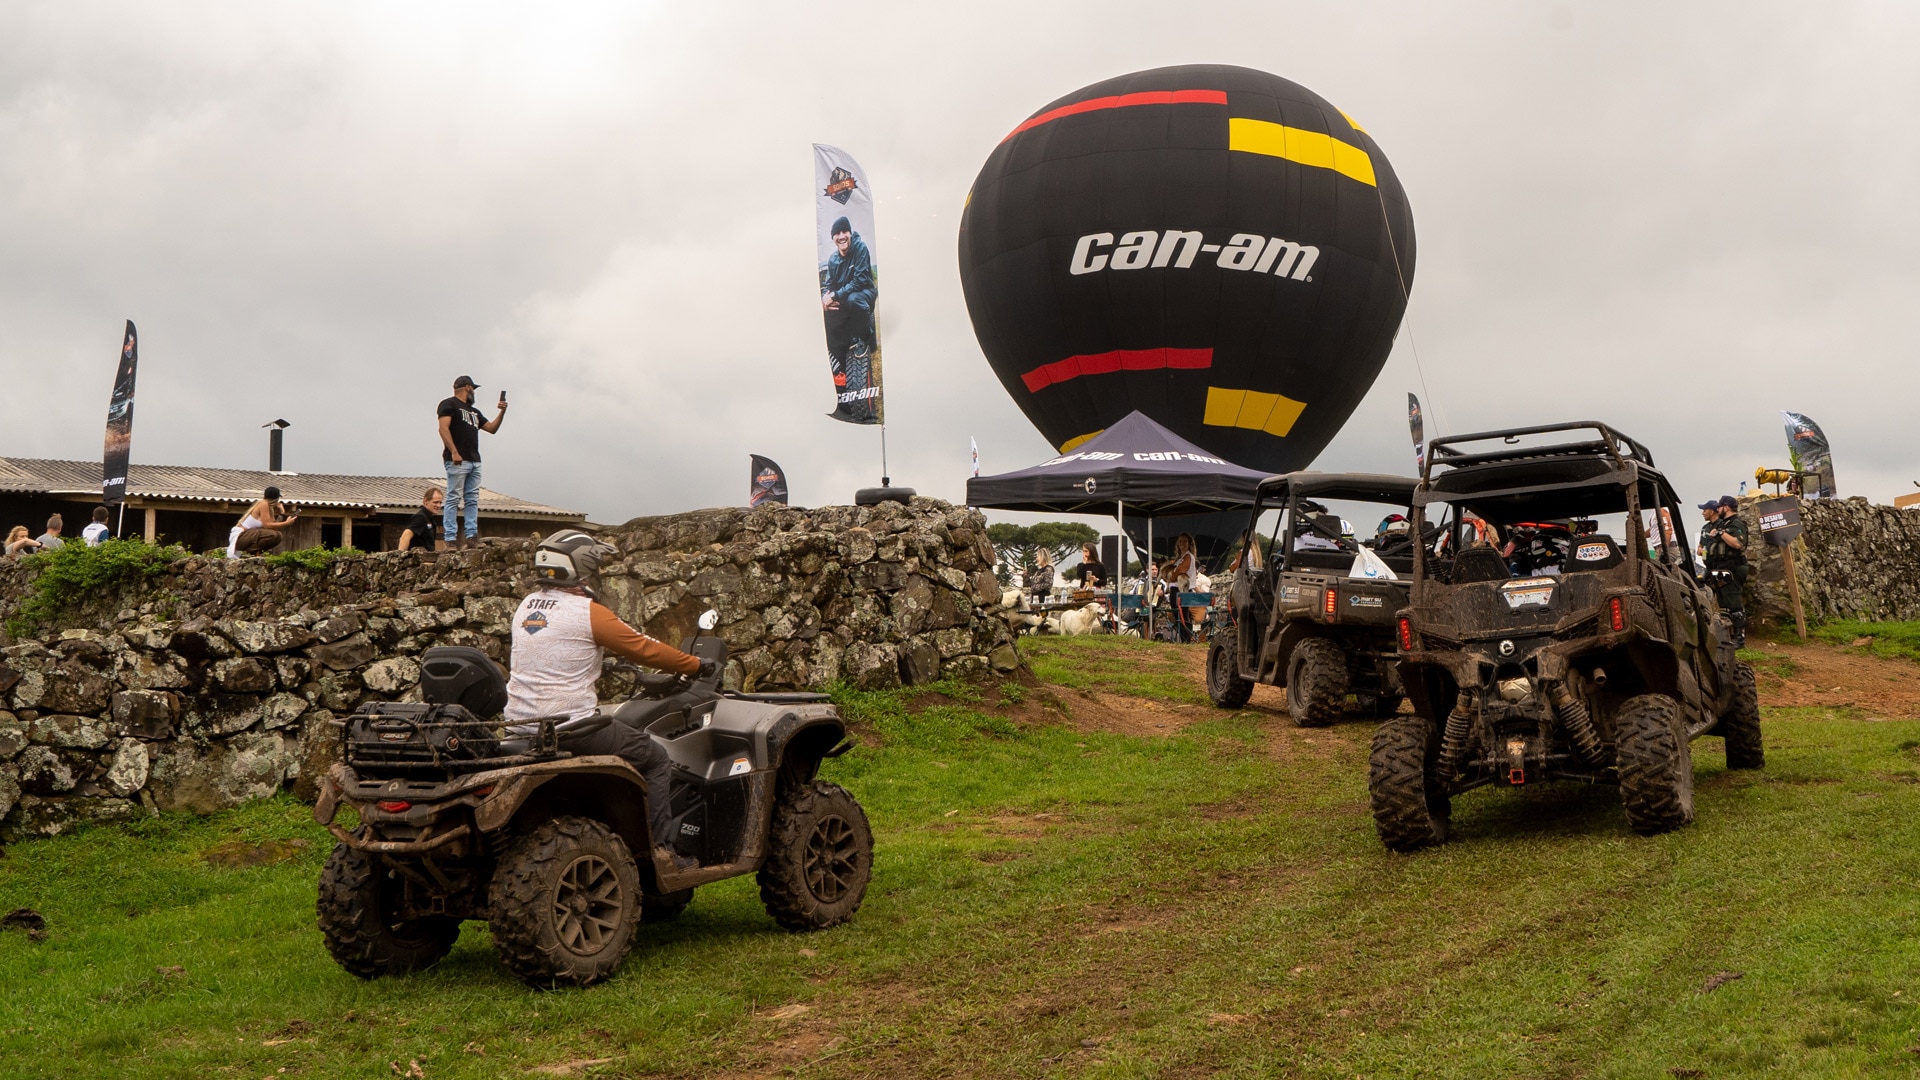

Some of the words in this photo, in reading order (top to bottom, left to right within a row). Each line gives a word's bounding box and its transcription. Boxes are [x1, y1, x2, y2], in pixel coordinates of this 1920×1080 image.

[1070, 230, 1320, 281] can-am
[1133, 451, 1229, 466] can-am
[103, 476, 126, 487] n-am
[526, 598, 559, 610] STAFF
[681, 823, 700, 832] 700
